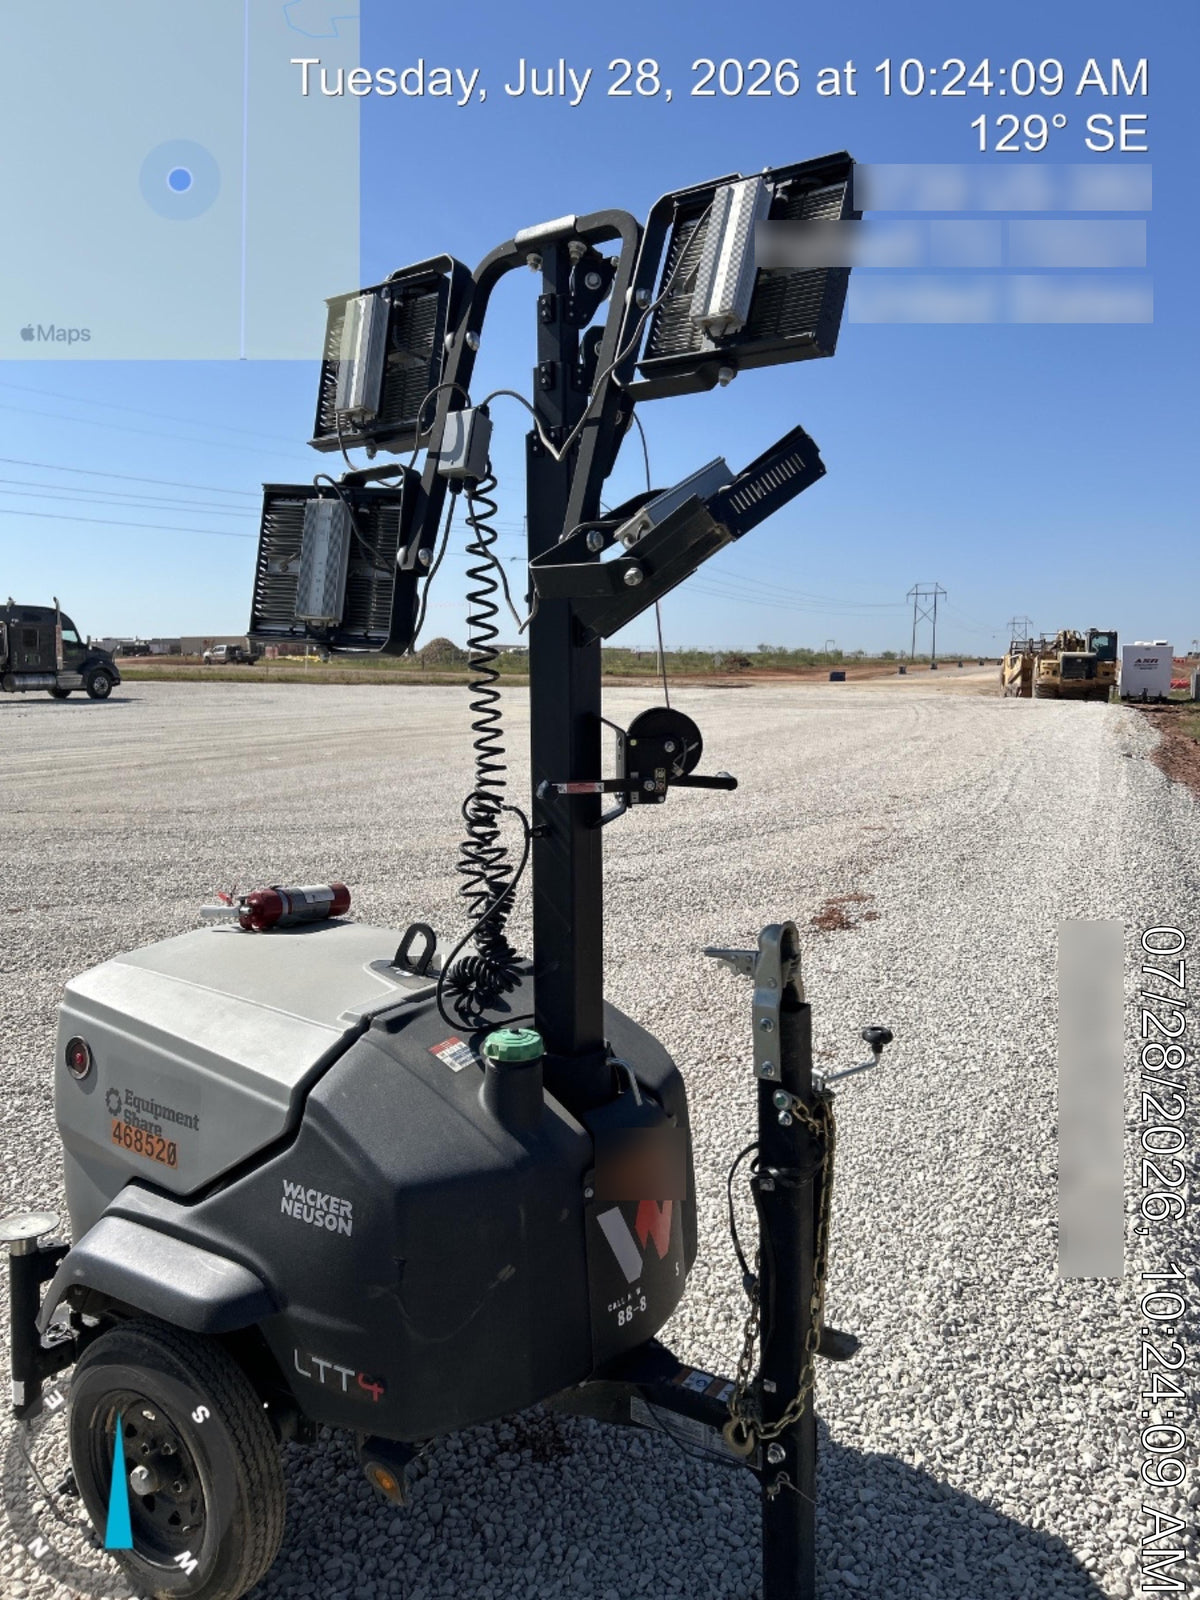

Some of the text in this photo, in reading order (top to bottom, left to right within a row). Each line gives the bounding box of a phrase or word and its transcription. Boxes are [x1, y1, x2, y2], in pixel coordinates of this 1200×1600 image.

[123, 1108, 163, 1137] Share
[124, 1088, 200, 1132] Equipment
[112, 1121, 177, 1167] 468520
[280, 1196, 353, 1237] NEUSON
[282, 1179, 353, 1220] WACKER
[294, 1348, 385, 1402] LTT4
